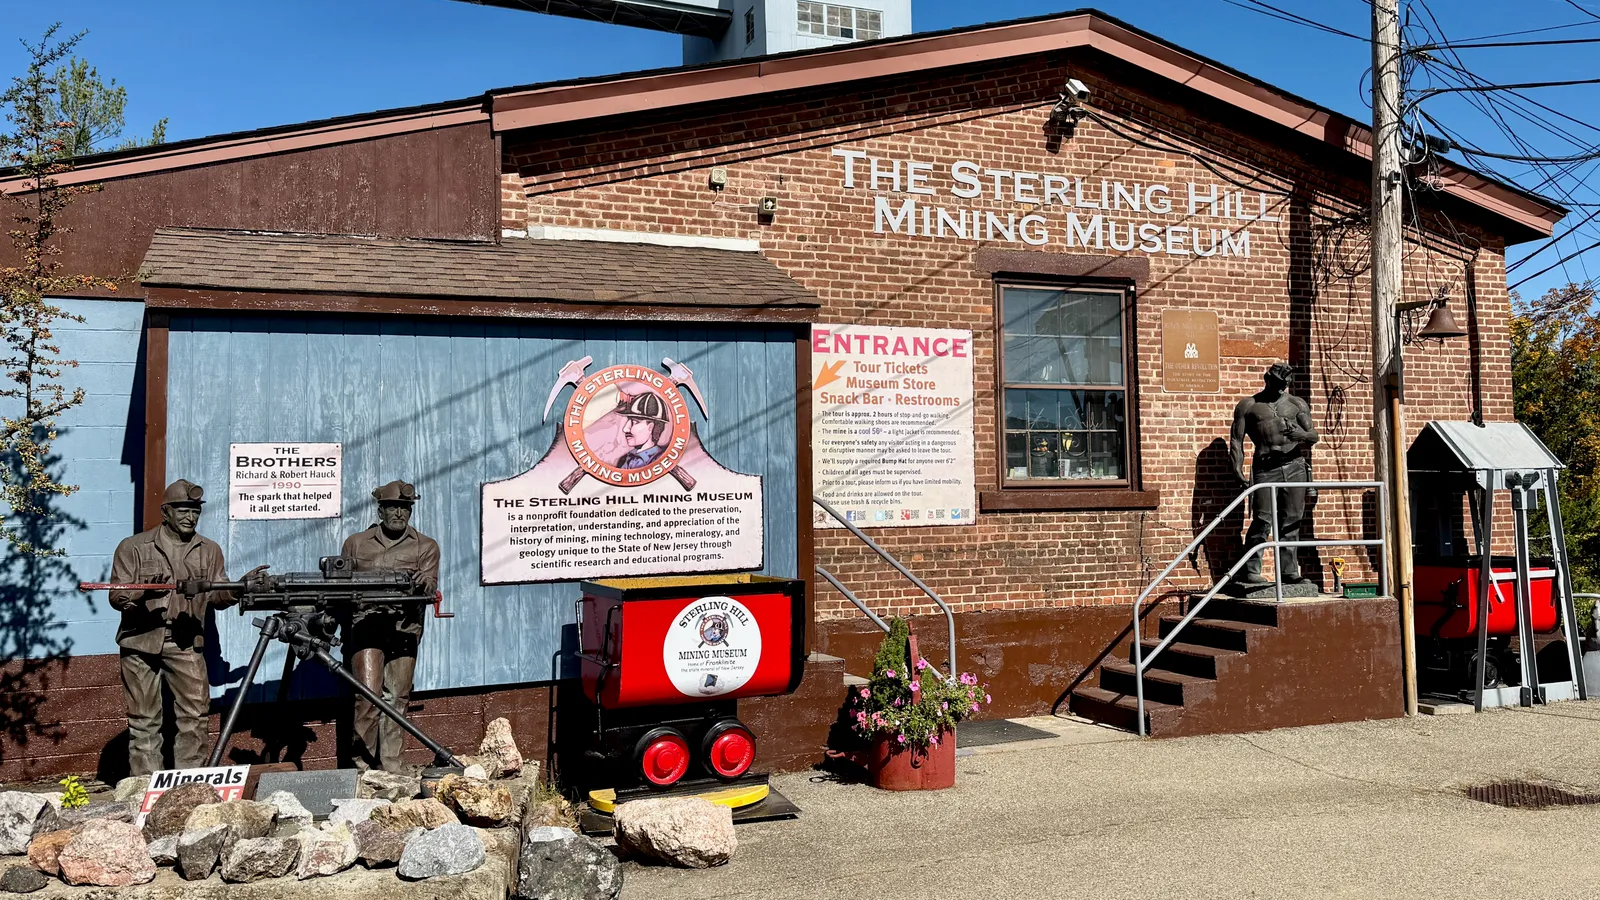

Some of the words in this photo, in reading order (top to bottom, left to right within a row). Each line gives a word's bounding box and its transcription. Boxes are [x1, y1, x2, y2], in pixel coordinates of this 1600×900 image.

[832, 149, 935, 195] THE
[950, 161, 1173, 214] STERLING
[1187, 182, 1281, 222] HILL
[873, 197, 1049, 245] MINING
[1065, 213, 1251, 258] MUSEUM
[813, 329, 967, 358] ENTRANCE
[854, 361, 881, 373] Tour
[884, 362, 928, 374] Tickets
[846, 377, 898, 389] Museum
[903, 378, 936, 390] Store
[569, 394, 586, 427] THE
[585, 368, 664, 394] STERLING
[664, 387, 685, 424] HILL
[820, 392, 859, 404] Snack
[863, 393, 884, 405] Bar
[896, 394, 960, 406] Restrooms
[236, 456, 336, 467] BROTHERS
[571, 440, 622, 482] MINING
[628, 437, 686, 483] MUSEUM
[310, 470, 336, 478] Hauck
[257, 492, 281, 502] spark
[303, 492, 332, 501] helped
[494, 498, 524, 508] THE
[529, 496, 600, 507] STERLING
[606, 495, 638, 505] HILL
[643, 494, 692, 504] MINING
[697, 492, 753, 502] MUSEUM
[272, 505, 285, 513] get
[288, 504, 320, 512] started.
[508, 512, 515, 520] is
[526, 511, 567, 522] nonprofit
[569, 509, 617, 519] foundation
[619, 508, 660, 518] dedicated
[673, 506, 687, 515] the
[689, 505, 742, 517] preservation,
[510, 522, 576, 534] interpretation,
[578, 520, 643, 532] understanding,
[646, 519, 662, 528] and
[664, 518, 714, 530] appreciation
[717, 517, 725, 525] of
[727, 516, 739, 524] the
[510, 535, 542, 547] history
[544, 535, 554, 544] of
[555, 534, 589, 545] mining,
[592, 533, 622, 544] mining
[624, 531, 673, 543] technology,
[675, 529, 723, 540] mineralogy,
[725, 528, 740, 537] and
[519, 547, 556, 560] geology
[558, 546, 588, 558] unique
[602, 544, 616, 553] the
[618, 544, 640, 553] State
[642, 543, 651, 552] of
[653, 542, 671, 551] New
[673, 541, 698, 553] Jersey
[700, 540, 732, 551] through
[531, 558, 572, 570] scientific
[574, 557, 610, 567] research
[613, 556, 629, 565] and
[632, 553, 681, 564] educational
[683, 552, 724, 564] programs.
[679, 601, 728, 628] STERLING
[729, 605, 749, 627] HILL
[679, 650, 709, 660] MINING
[712, 649, 747, 658] MUSEUM
[153, 768, 242, 789] Minerals
